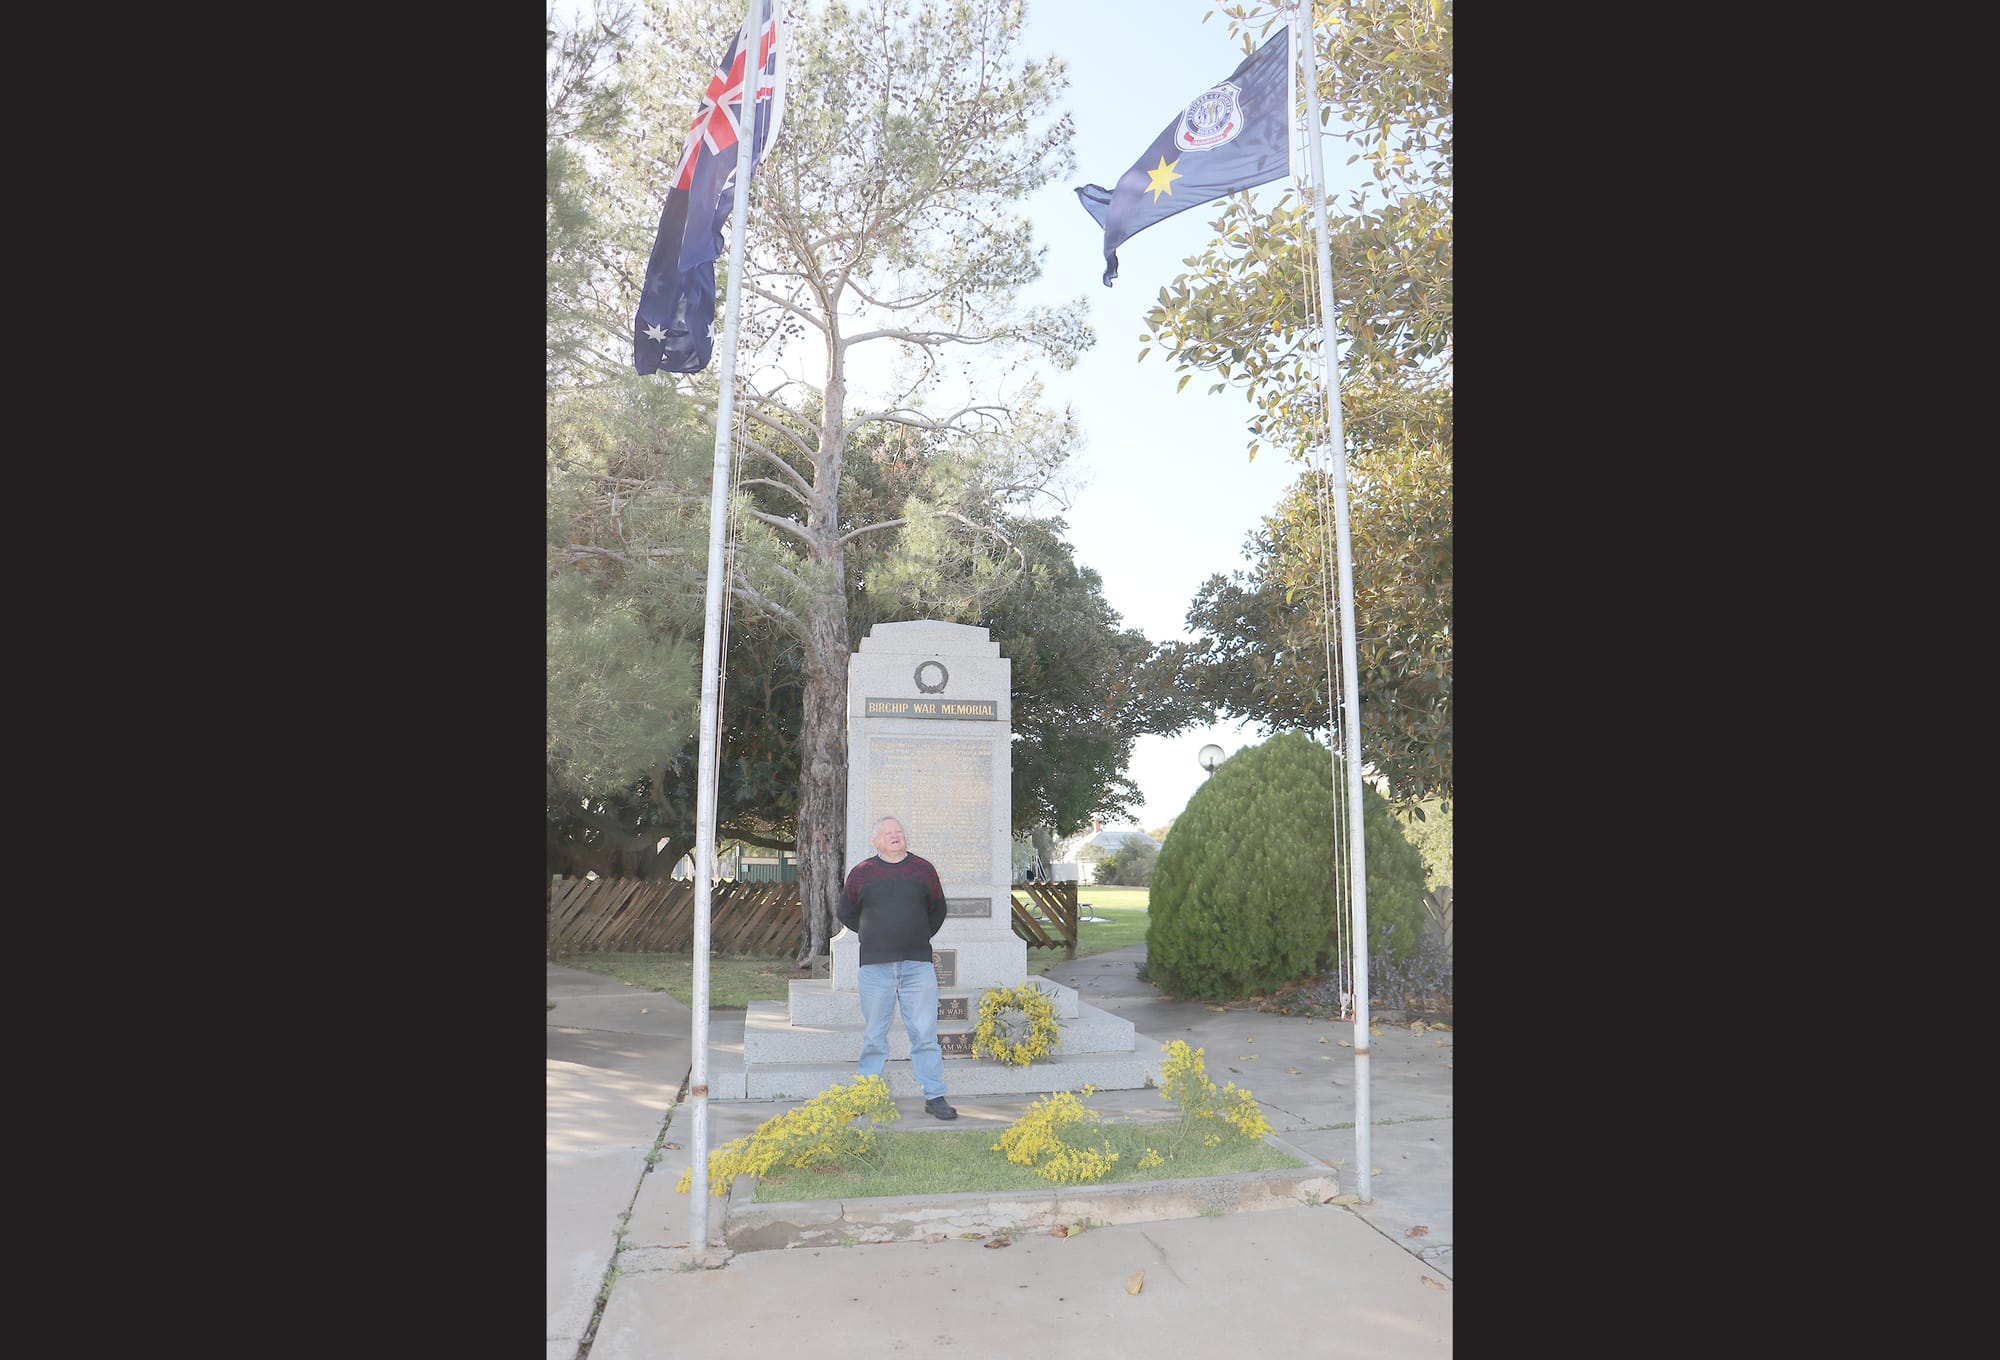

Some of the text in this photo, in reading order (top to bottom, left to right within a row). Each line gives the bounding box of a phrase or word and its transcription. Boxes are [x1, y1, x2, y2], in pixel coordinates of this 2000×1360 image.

[869, 703, 994, 715] BIRCHIP WAR MEMORIAL
